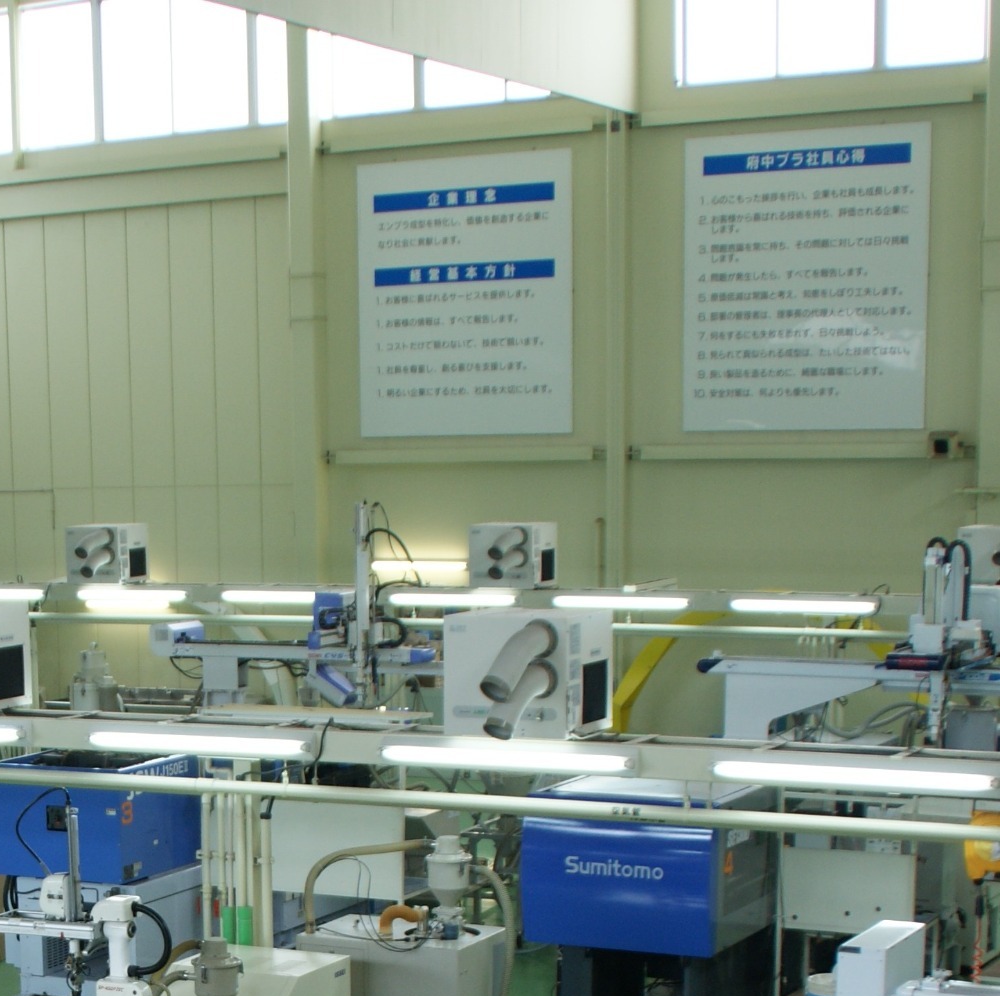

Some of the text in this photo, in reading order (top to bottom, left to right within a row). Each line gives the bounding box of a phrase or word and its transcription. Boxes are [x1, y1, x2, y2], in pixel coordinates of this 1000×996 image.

[746, 149, 866, 170] 府中プラ社員心得
[427, 188, 497, 207] 企業理念
[409, 264, 517, 283] 経営基本方針
[565, 855, 664, 880] Sumitomo
